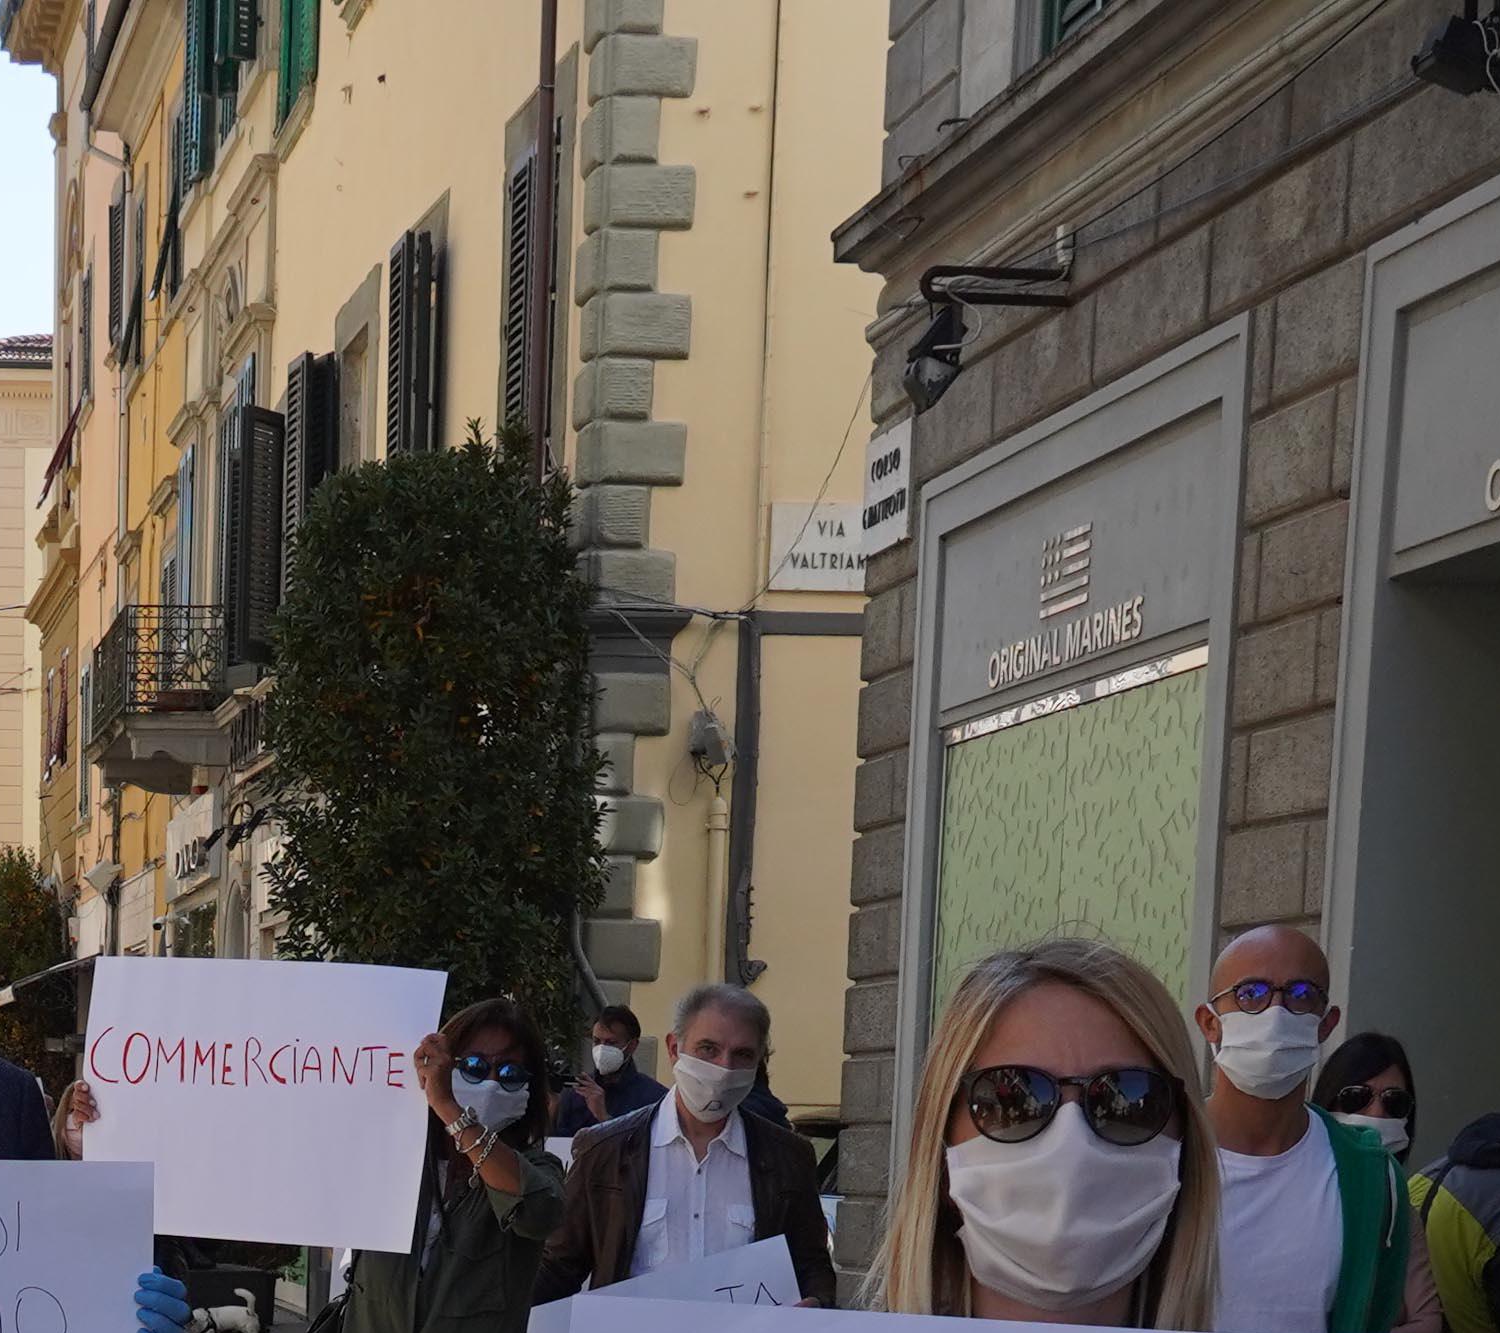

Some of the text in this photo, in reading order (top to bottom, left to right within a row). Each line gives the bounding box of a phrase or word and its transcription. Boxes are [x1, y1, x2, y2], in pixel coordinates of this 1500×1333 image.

[871, 447, 901, 483] CORSO
[818, 520, 845, 537] VIA
[988, 596, 1145, 689] ORIGINAL MARINES
